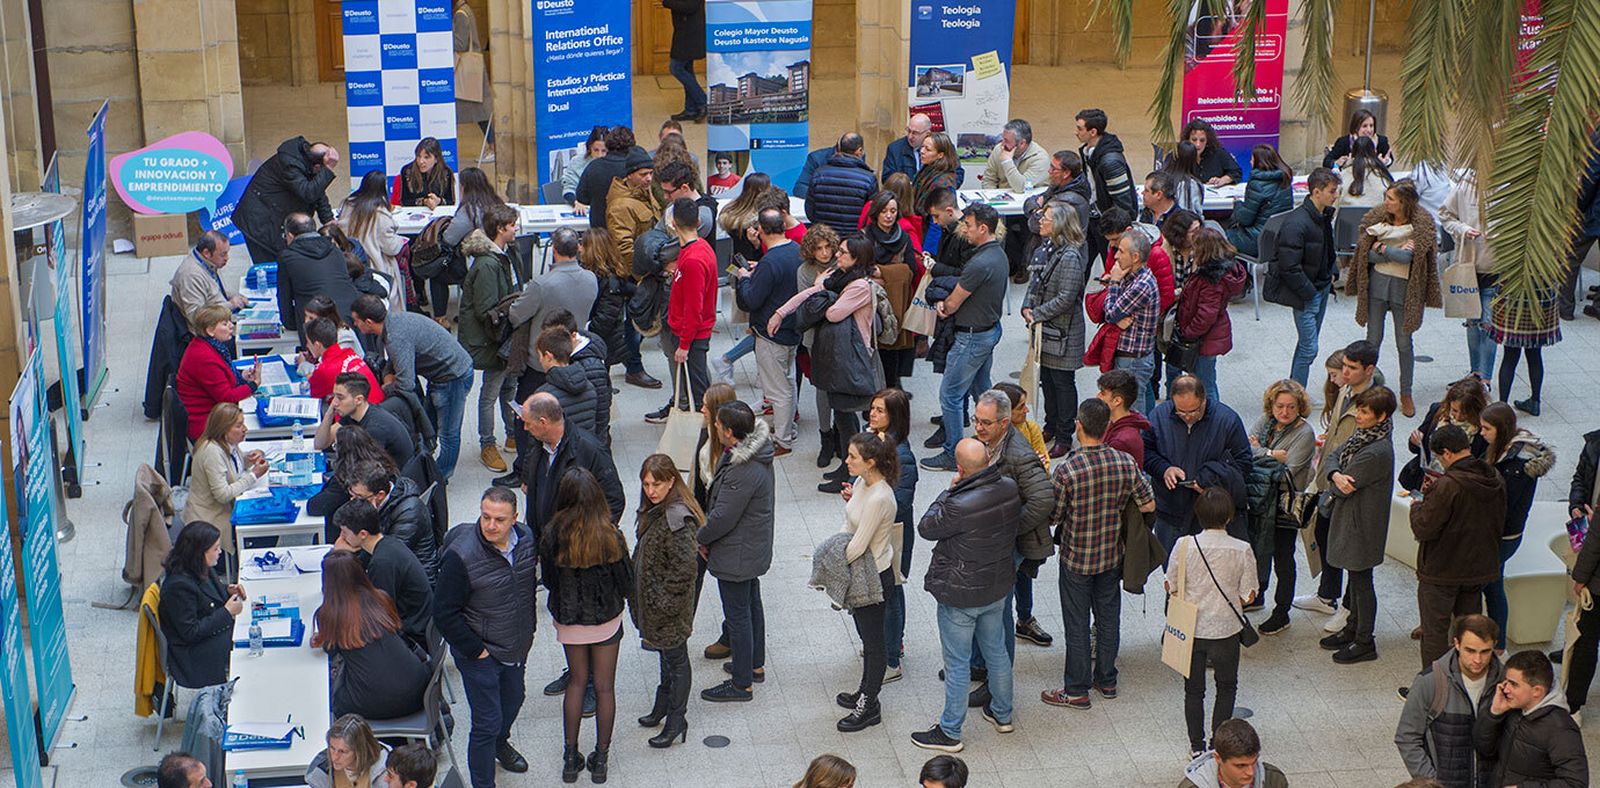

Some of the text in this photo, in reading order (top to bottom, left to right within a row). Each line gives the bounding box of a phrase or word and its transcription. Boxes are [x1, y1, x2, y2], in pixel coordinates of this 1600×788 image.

[544, 0, 574, 9] Deusto
[545, 24, 609, 40] International
[714, 29, 743, 38] Colegio
[744, 28, 769, 36] Mayor
[546, 35, 624, 52] Relations Office
[714, 35, 809, 46] Deusto Ikastetxe Nagusia
[547, 76, 582, 88] Estudios
[583, 77, 588, 85] y
[547, 84, 609, 97] Internacionales
[548, 102, 569, 112] iDual
[143, 158, 157, 167] TU
[160, 158, 199, 167] GRADO
[135, 170, 217, 180] INNOVACION Y
[128, 182, 223, 192] EMPRENDIMIENTO
[212, 215, 233, 231] EKIN
